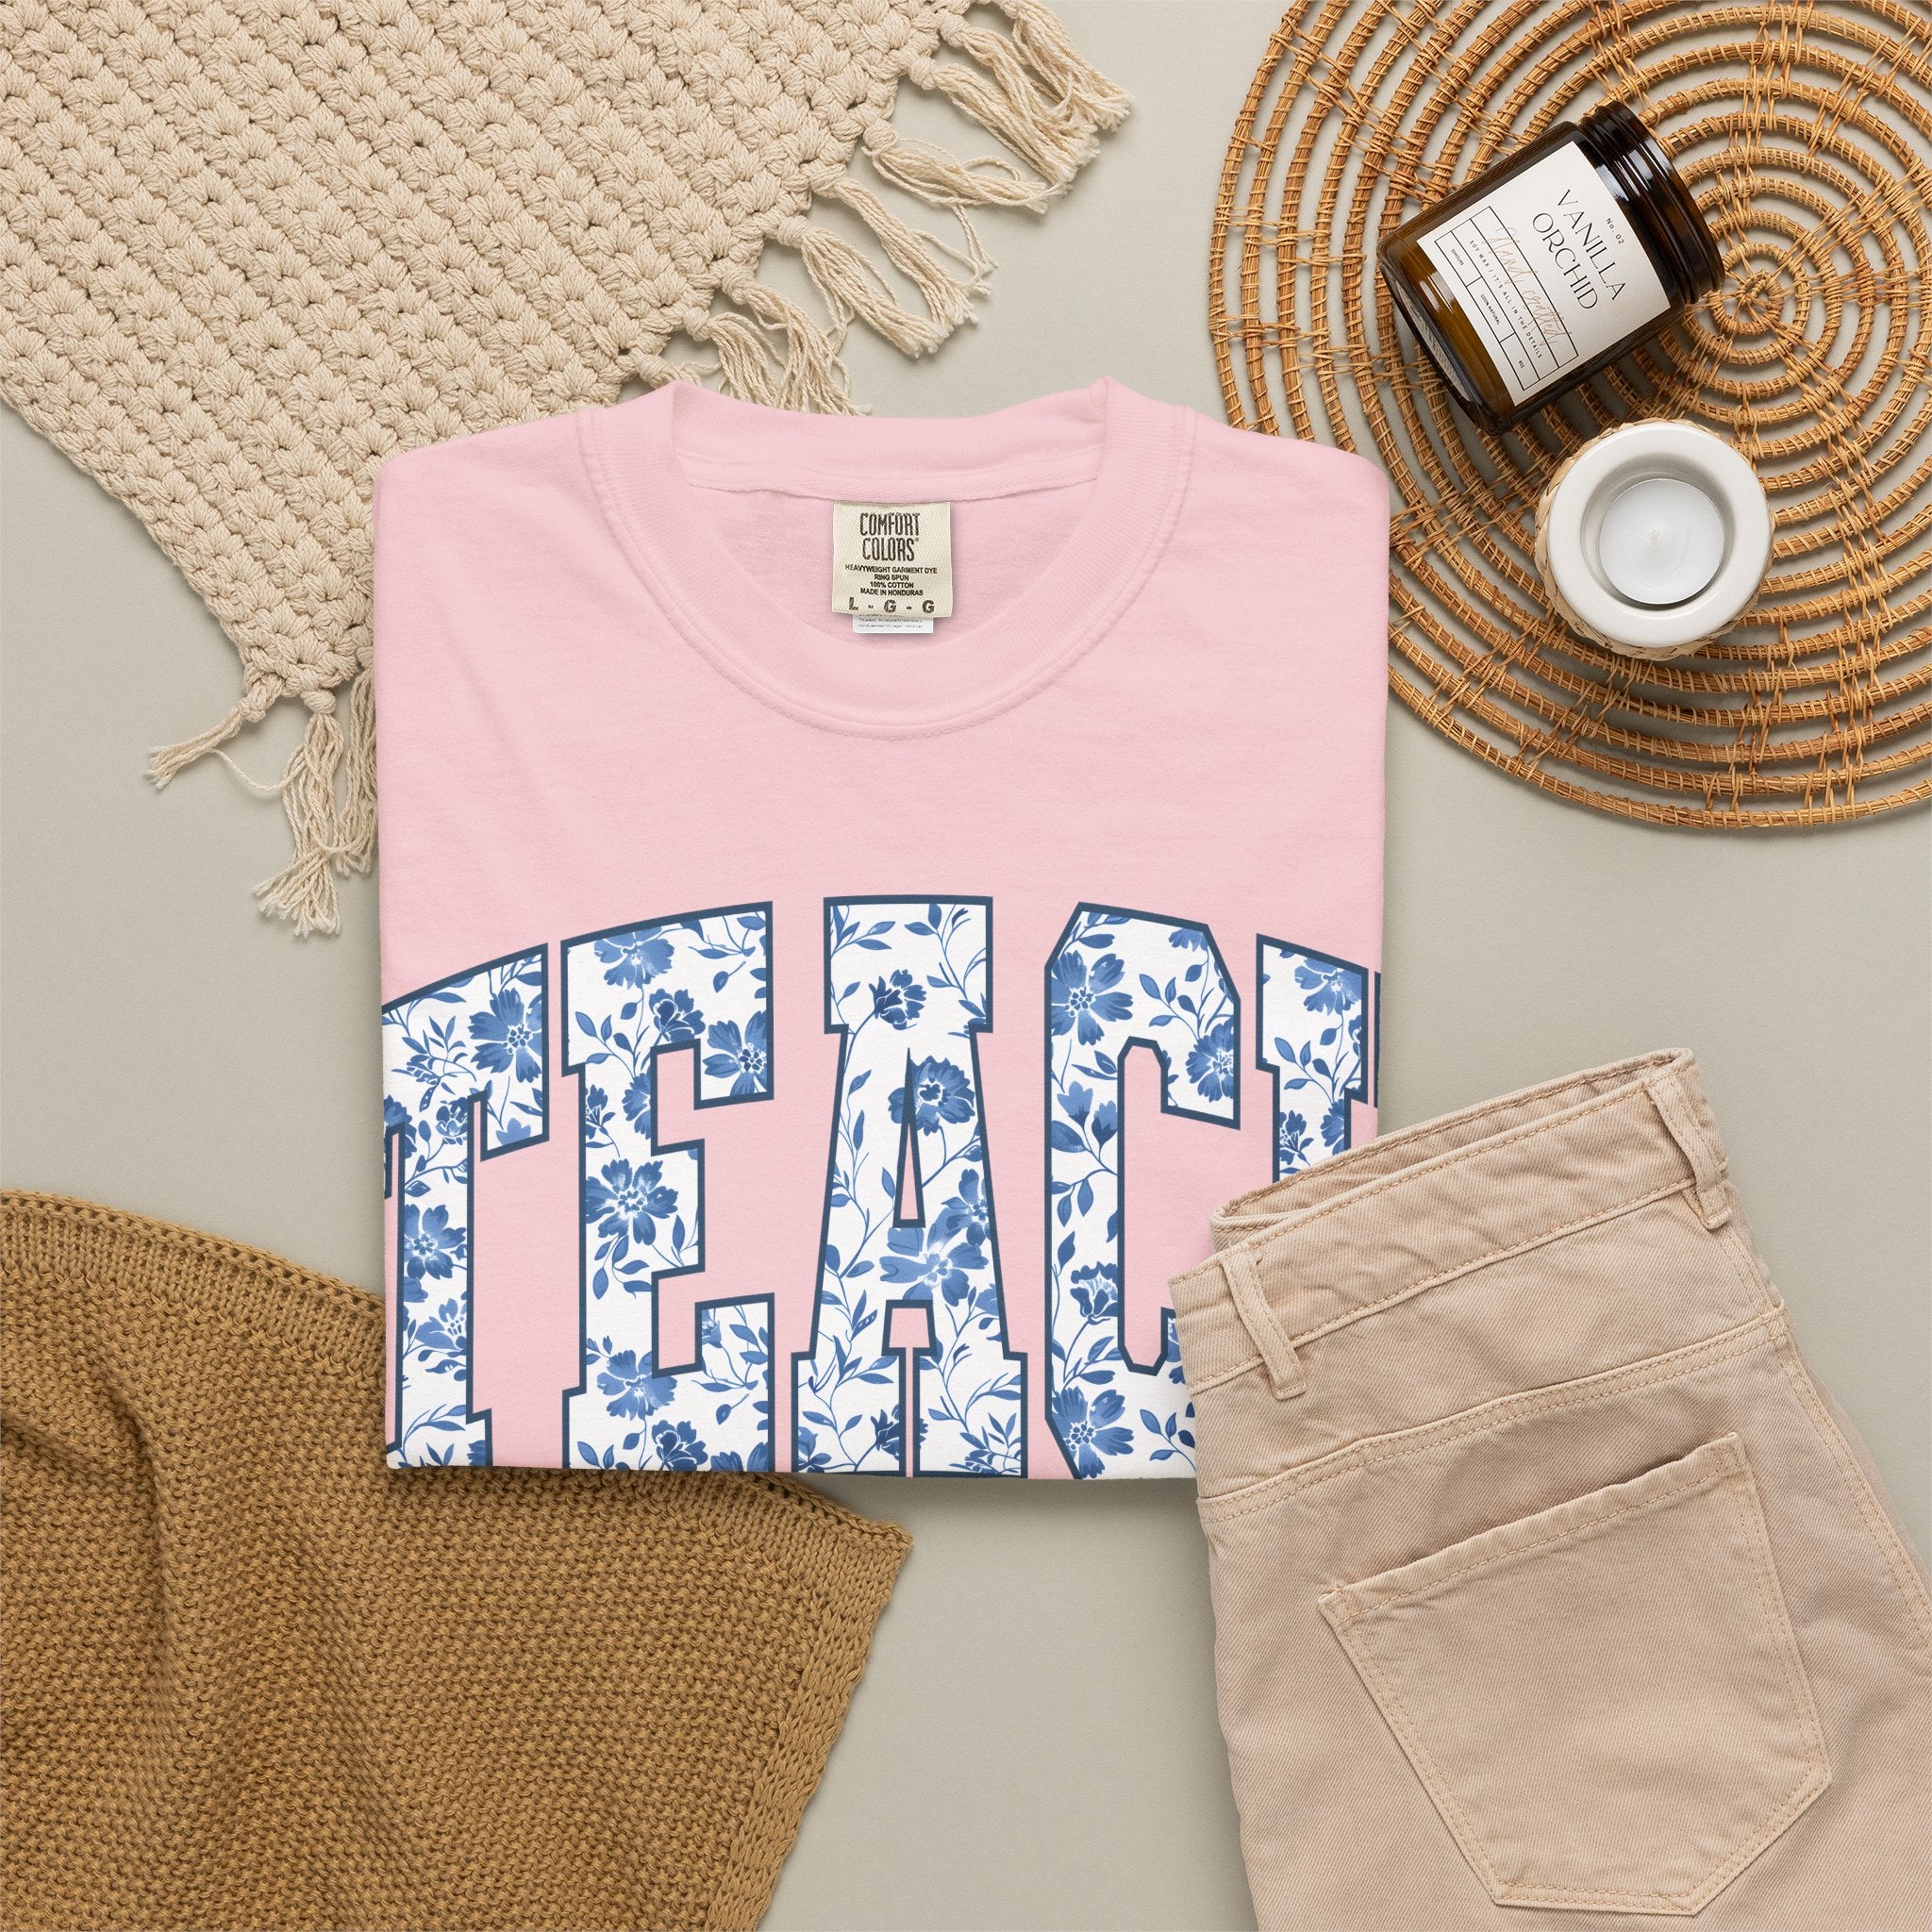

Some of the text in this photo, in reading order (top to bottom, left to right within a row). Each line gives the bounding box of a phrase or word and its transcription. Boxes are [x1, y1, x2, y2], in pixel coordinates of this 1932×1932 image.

[1606, 218, 1624, 244] No. 02
[1557, 189, 1626, 300] VANILLA
[1533, 213, 1599, 309] ORCHID
[1470, 241, 1479, 251] SOY
[1479, 253, 1490, 267] WAX
[1492, 275, 1503, 289] IT'S
[1503, 291, 1511, 304] ALL
[1511, 306, 1518, 314] IN
[1518, 316, 1527, 329] THE
[1526, 332, 1543, 358] DETAILS
[1488, 306, 1501, 325] NATURAL
[859, 512, 921, 536] COMFORT
[844, 564, 891, 573] HEAVYWEIGHT
[849, 596, 859, 610] L
[883, 599, 897, 613] G
[922, 600, 935, 614] G
[381, 894, 1381, 1479] TEAC
